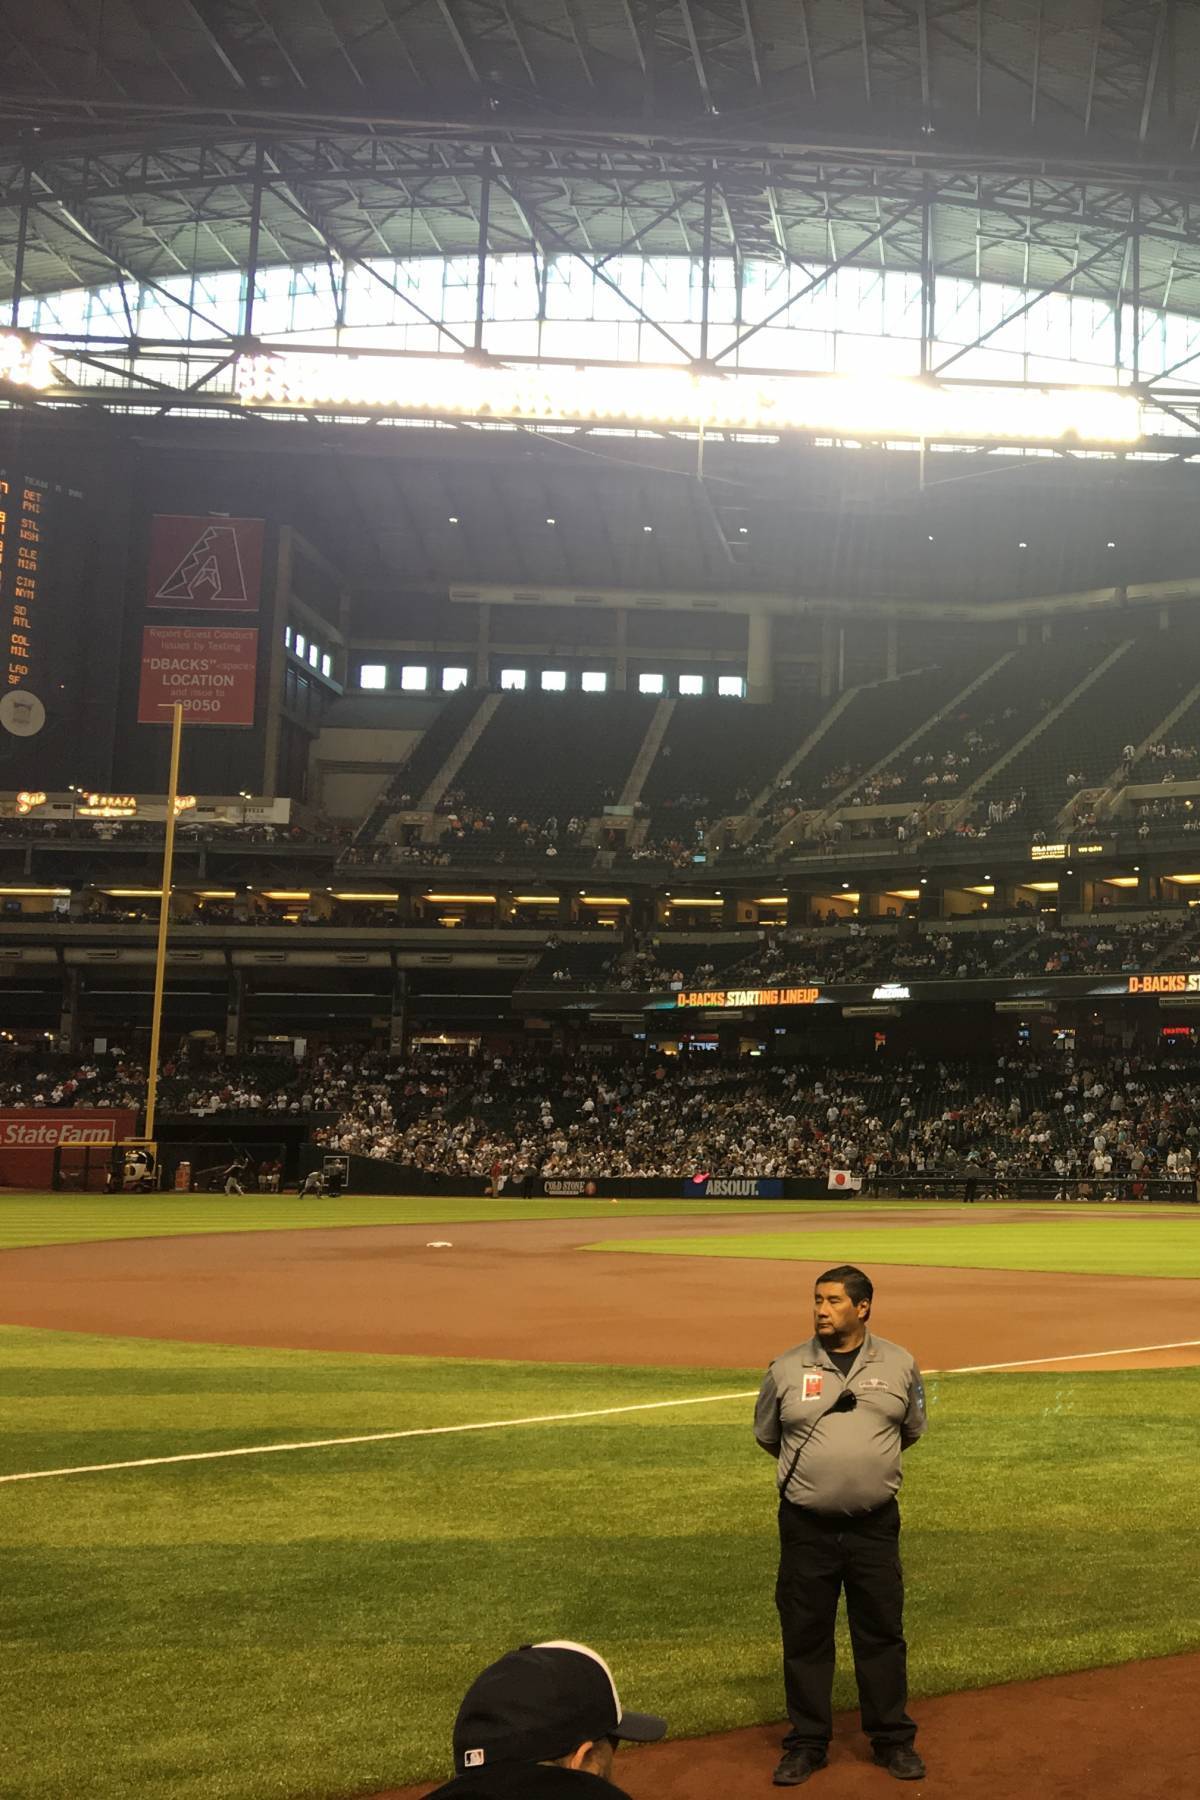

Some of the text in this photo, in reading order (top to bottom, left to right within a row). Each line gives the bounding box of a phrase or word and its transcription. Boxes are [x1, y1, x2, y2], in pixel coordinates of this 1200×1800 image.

[23, 489, 41, 502] DET
[22, 501, 40, 513] PHI
[21, 518, 39, 531] STL
[20, 529, 39, 542] WSH
[18, 547, 37, 559] CLE
[17, 559, 37, 571] MIA
[16, 575, 35, 588] CIN
[15, 588, 34, 600] NYM
[14, 605, 27, 616] SD
[13, 616, 31, 628] ATL
[11, 633, 31, 646] COL
[214, 630, 254, 640] Conduct
[10, 645, 30, 657] MIL
[8, 663, 28, 675] LAD
[8, 674, 21, 685] SF
[162, 674, 235, 686] LOCATION
[1129, 975, 1186, 993] D-BACKS
[677, 992, 724, 1008] D-BACKS
[724, 990, 778, 1007] STARTING
[780, 988, 819, 1005] LINEUP
[562, 1181, 586, 1193] STONE
